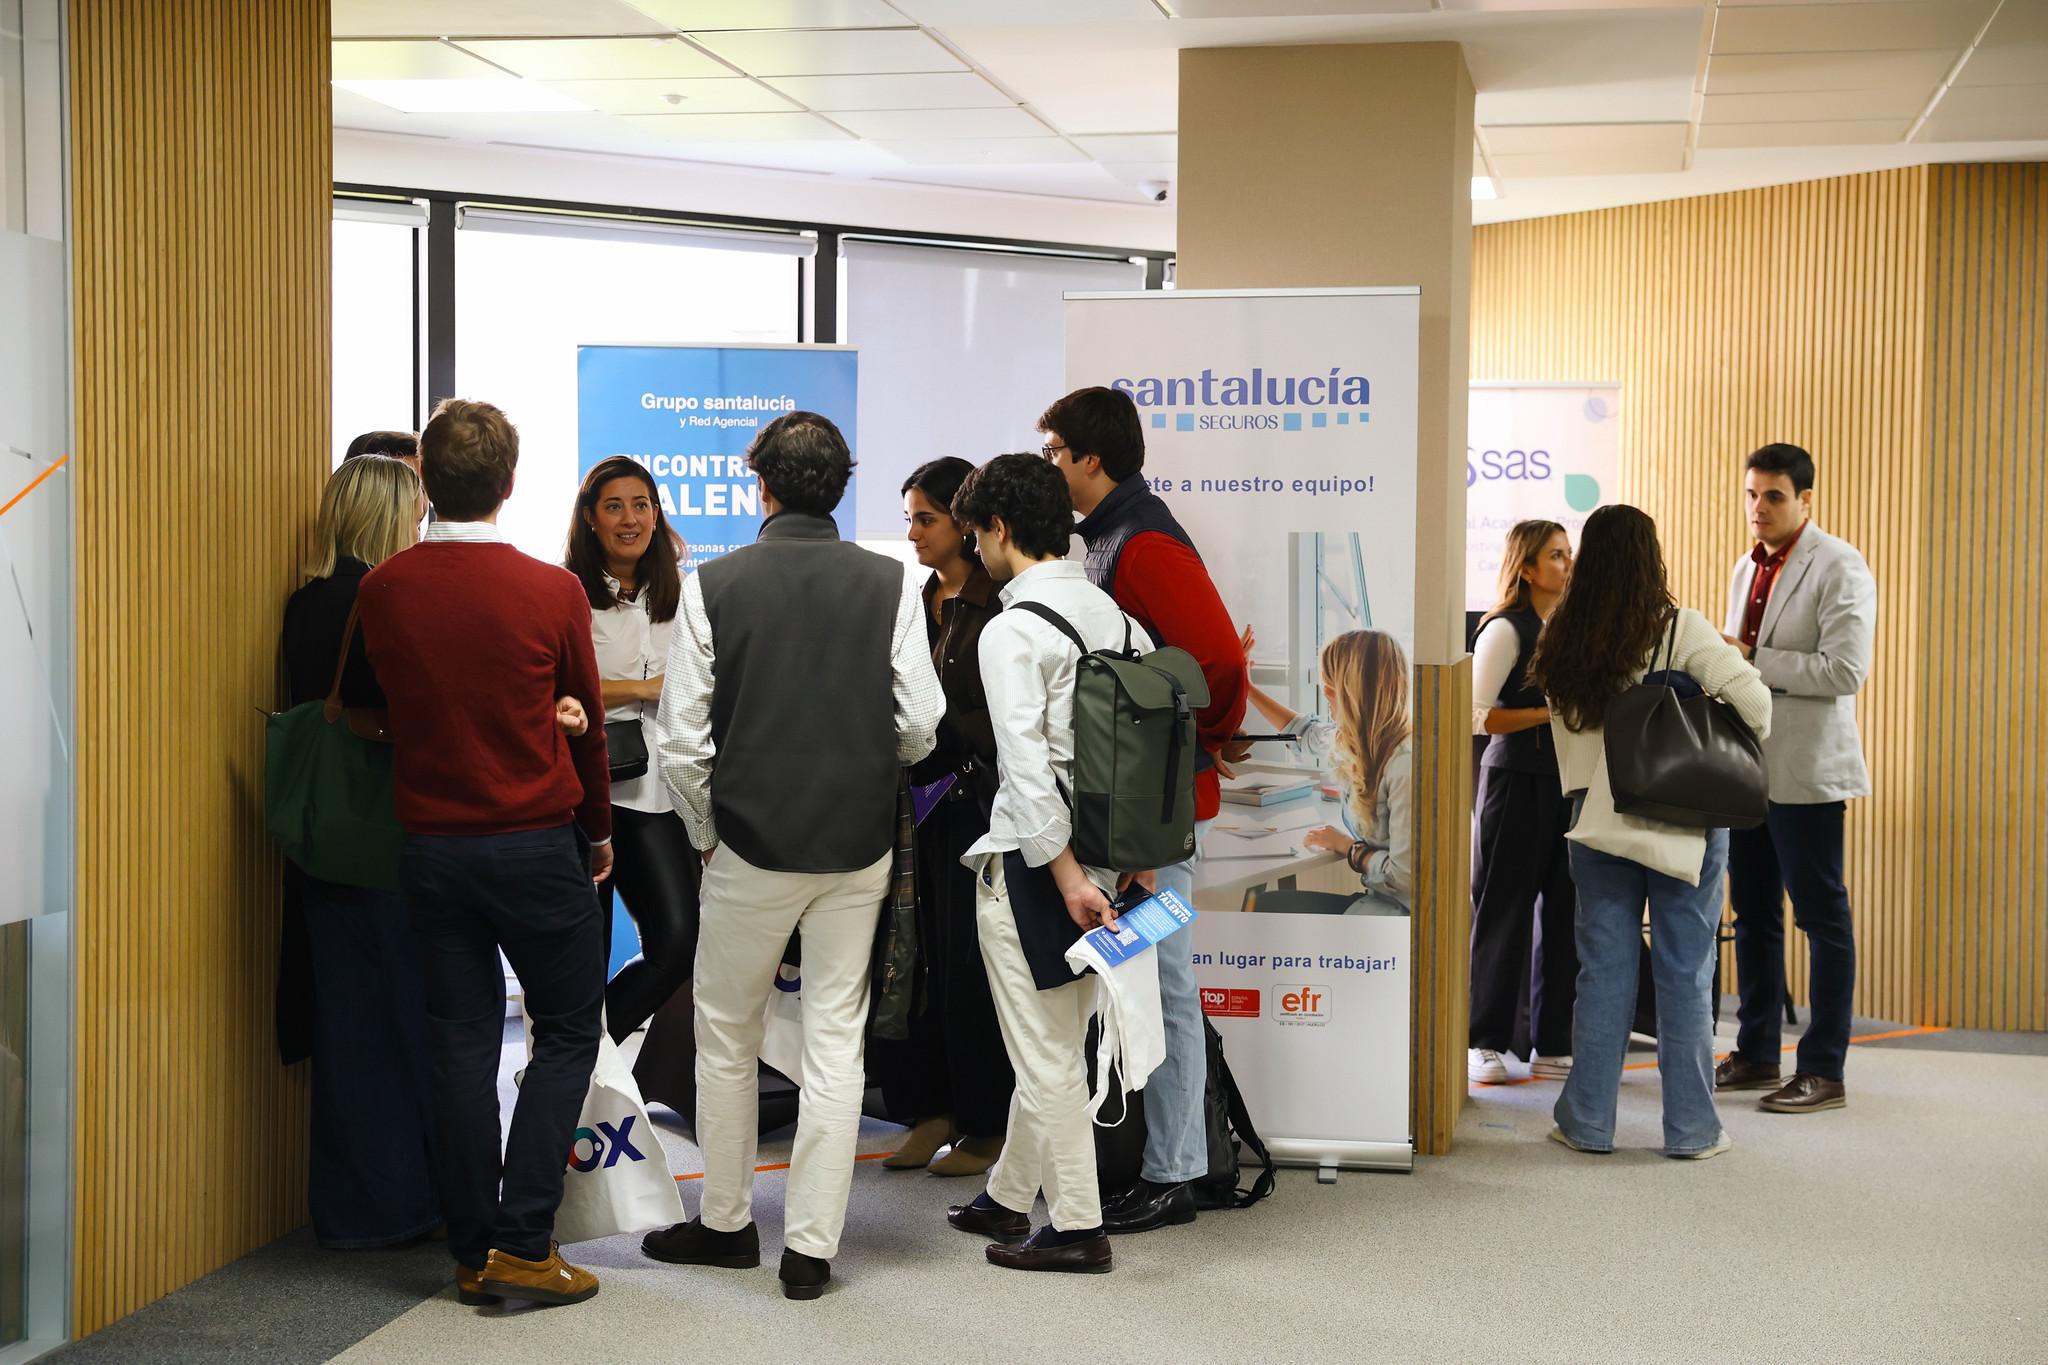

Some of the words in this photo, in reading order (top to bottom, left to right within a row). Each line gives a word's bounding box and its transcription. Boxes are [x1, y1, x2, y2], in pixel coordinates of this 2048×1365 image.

[1111, 367, 1370, 407] santalucía
[640, 392, 698, 413] Grupo
[703, 395, 795, 411] santalucía
[680, 418, 686, 428] y
[689, 416, 711, 427] Red
[713, 417, 758, 429] Agencial
[1199, 414, 1278, 431] SEGUROS
[1481, 449, 1551, 480] sas
[1181, 480, 1192, 492] a
[1201, 476, 1284, 492] nuestro
[1292, 475, 1374, 497] equipo!
[658, 483, 757, 516] ALEN
[1157, 892, 1189, 923] TALENTO
[1192, 953, 1213, 965] an
[1219, 951, 1266, 969] lugar
[1272, 955, 1312, 969] para
[1319, 954, 1396, 973] trabajar!
[1202, 989, 1225, 1006] top
[1282, 987, 1322, 1013] efr
